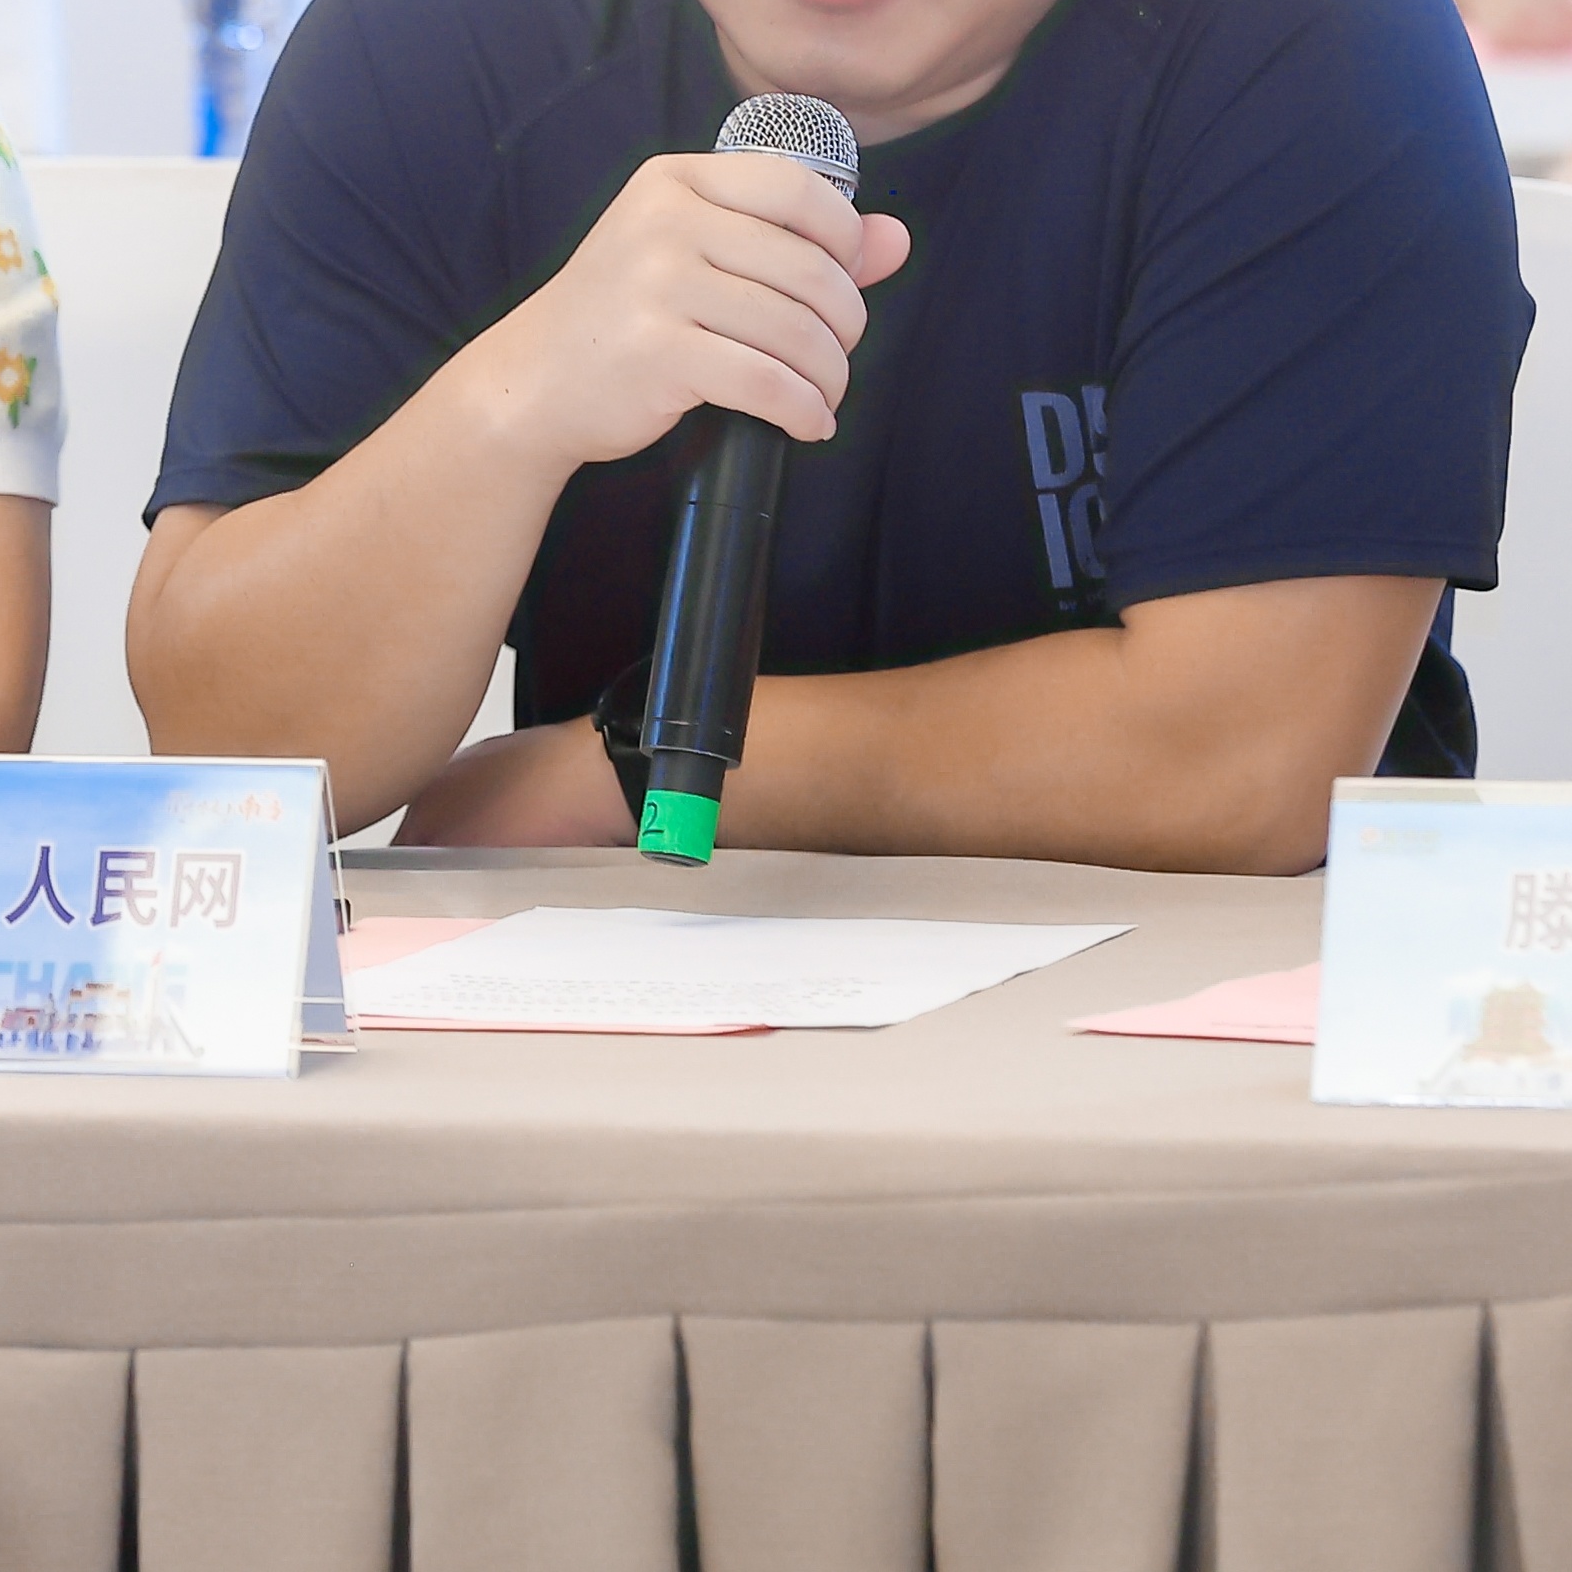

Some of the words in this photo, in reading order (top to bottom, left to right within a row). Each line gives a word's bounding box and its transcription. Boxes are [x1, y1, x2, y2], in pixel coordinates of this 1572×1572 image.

[642, 802, 664, 836] 2
[4, 845, 242, 927] 人民网
